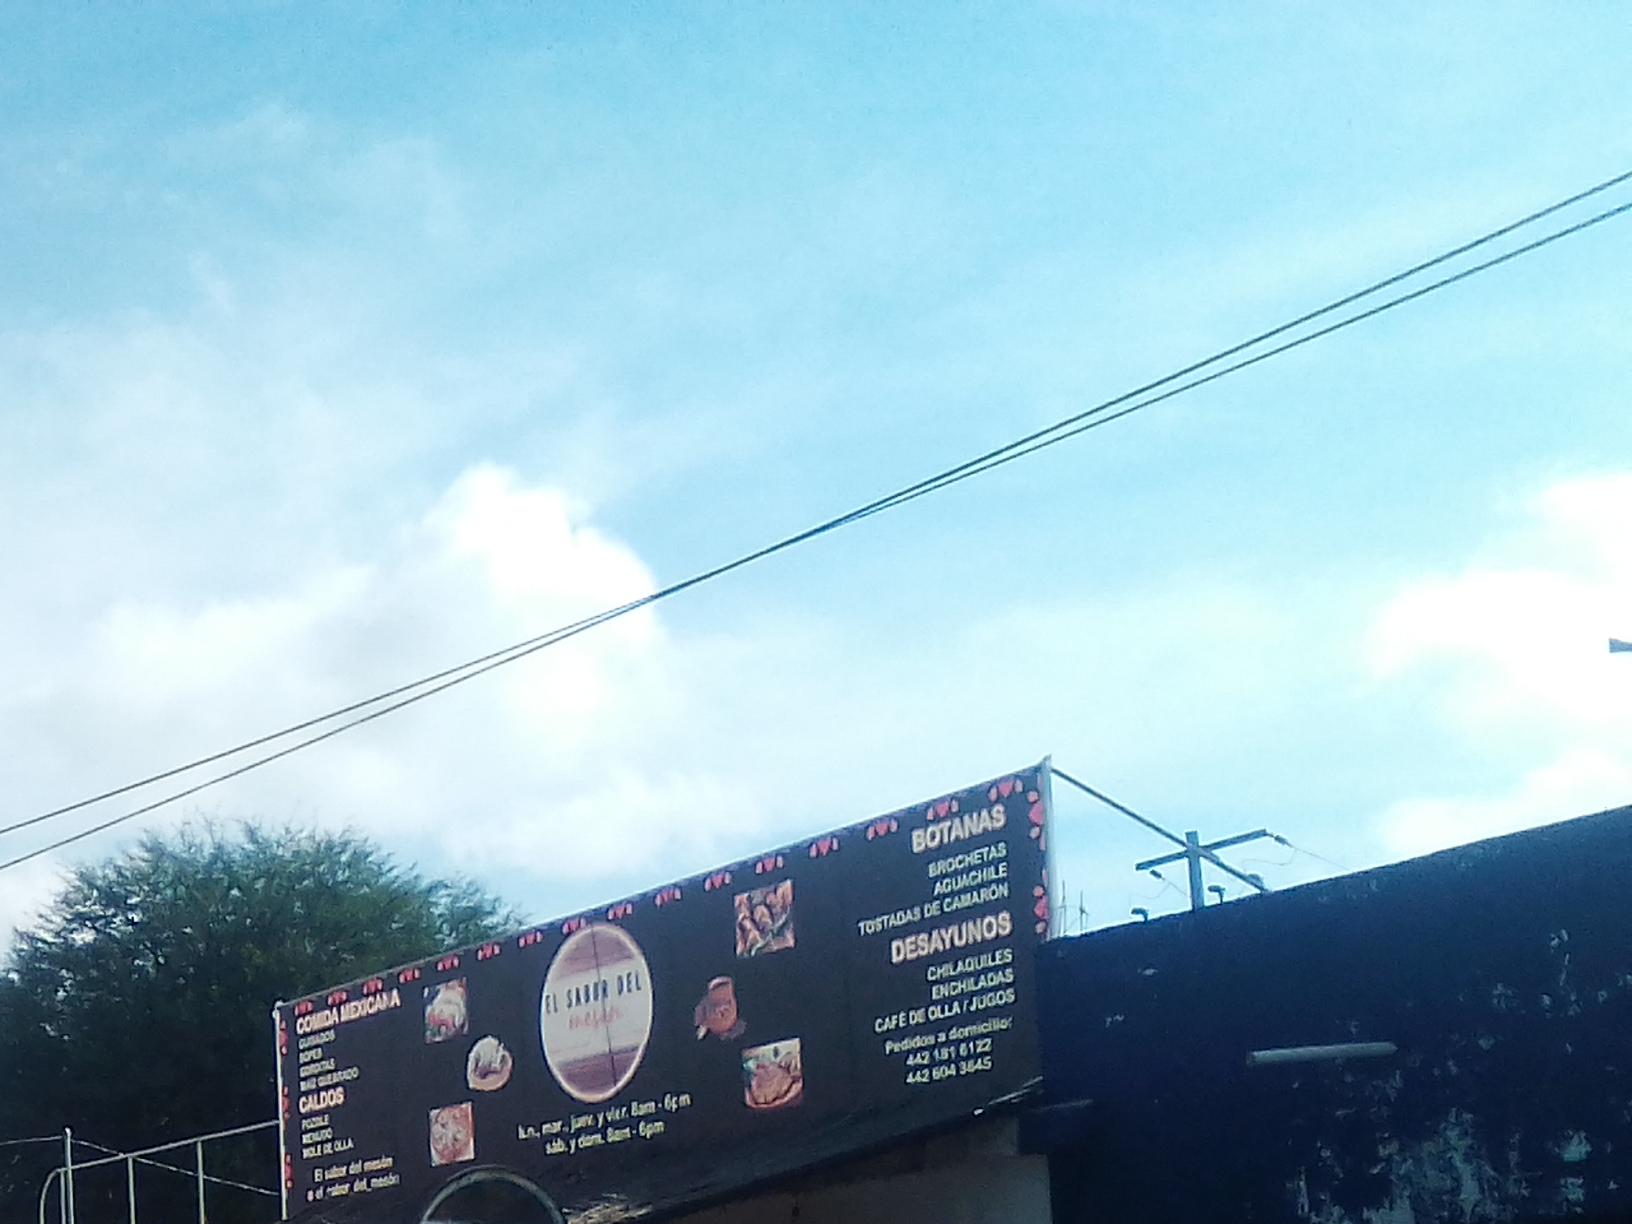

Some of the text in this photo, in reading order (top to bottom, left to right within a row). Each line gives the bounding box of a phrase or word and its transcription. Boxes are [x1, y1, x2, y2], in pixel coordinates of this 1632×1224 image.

[911, 803, 1007, 853] BOTANAS
[928, 842, 1007, 877] BROCHETAS
[933, 862, 1008, 896] AGUACHILE
[858, 906, 921, 936] TOSTADAS
[924, 900, 941, 918] DE
[891, 911, 1013, 963] DESAYUNOS
[927, 948, 1013, 981] CHILAQUILES
[544, 970, 642, 1015] EL SABOR DEL
[931, 969, 1014, 1000] ENCHILADAS
[296, 987, 401, 1035] COMIDA MEXICANA
[874, 1011, 907, 1032] CAFÉ
[909, 1007, 926, 1025] DE
[927, 1000, 961, 1021] OLLA
[969, 988, 1016, 1012] JUGOS
[885, 1036, 936, 1055] Pedidos
[937, 1032, 947, 1043] a
[906, 1051, 930, 1066] 442
[906, 1068, 930, 1083] 442
[299, 1085, 345, 1114] CALDOS
[334, 1137, 355, 1152] OLLA
